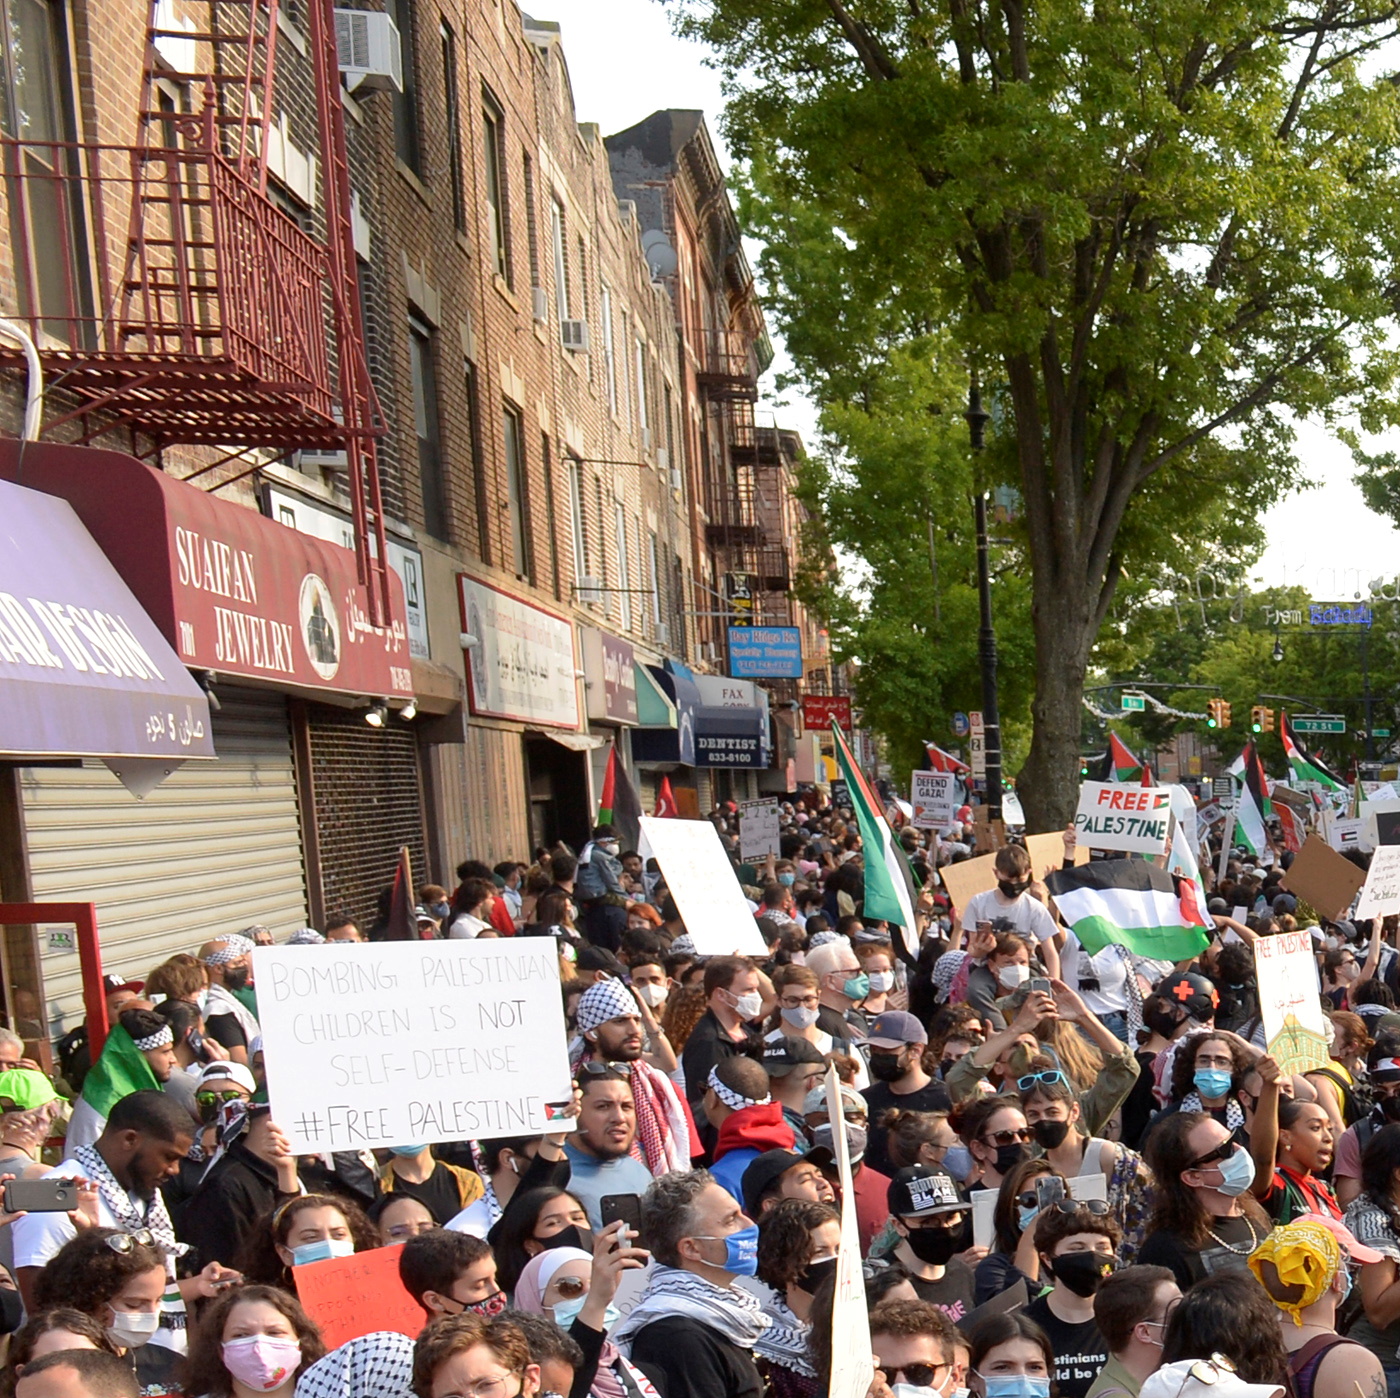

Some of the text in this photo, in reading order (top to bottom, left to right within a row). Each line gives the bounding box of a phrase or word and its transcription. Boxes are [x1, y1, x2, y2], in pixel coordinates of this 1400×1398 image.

[175, 526, 257, 605] SUAIFAN
[28, 598, 165, 681] DESIGN
[214, 606, 295, 674] JEWELRY
[731, 630, 780, 645] Bay Ridge
[722, 689, 743, 699] FAX
[1305, 722, 1332, 731] 72 St
[698, 738, 757, 750] DENTIST
[972, 738, 980, 750] 2
[708, 753, 751, 763] 833-8100
[916, 777, 947, 788] DEFEND
[918, 788, 945, 798] GAZA!
[1097, 789, 1150, 811] FREE
[1075, 813, 1167, 841] PALESTINE
[1256, 931, 1312, 960] FREE PALESTINE
[270, 954, 558, 1001] BOMBING PALESTINIAN
[293, 1000, 526, 1045] CHILDREN IS NOT
[330, 1045, 519, 1087] SELF-DEFENSE
[294, 1096, 542, 1146] #FREE PALESTINE
[911, 1187, 952, 1204] SLAM
[1053, 1352, 1106, 1365] stinians
[1074, 1367, 1092, 1379] be
